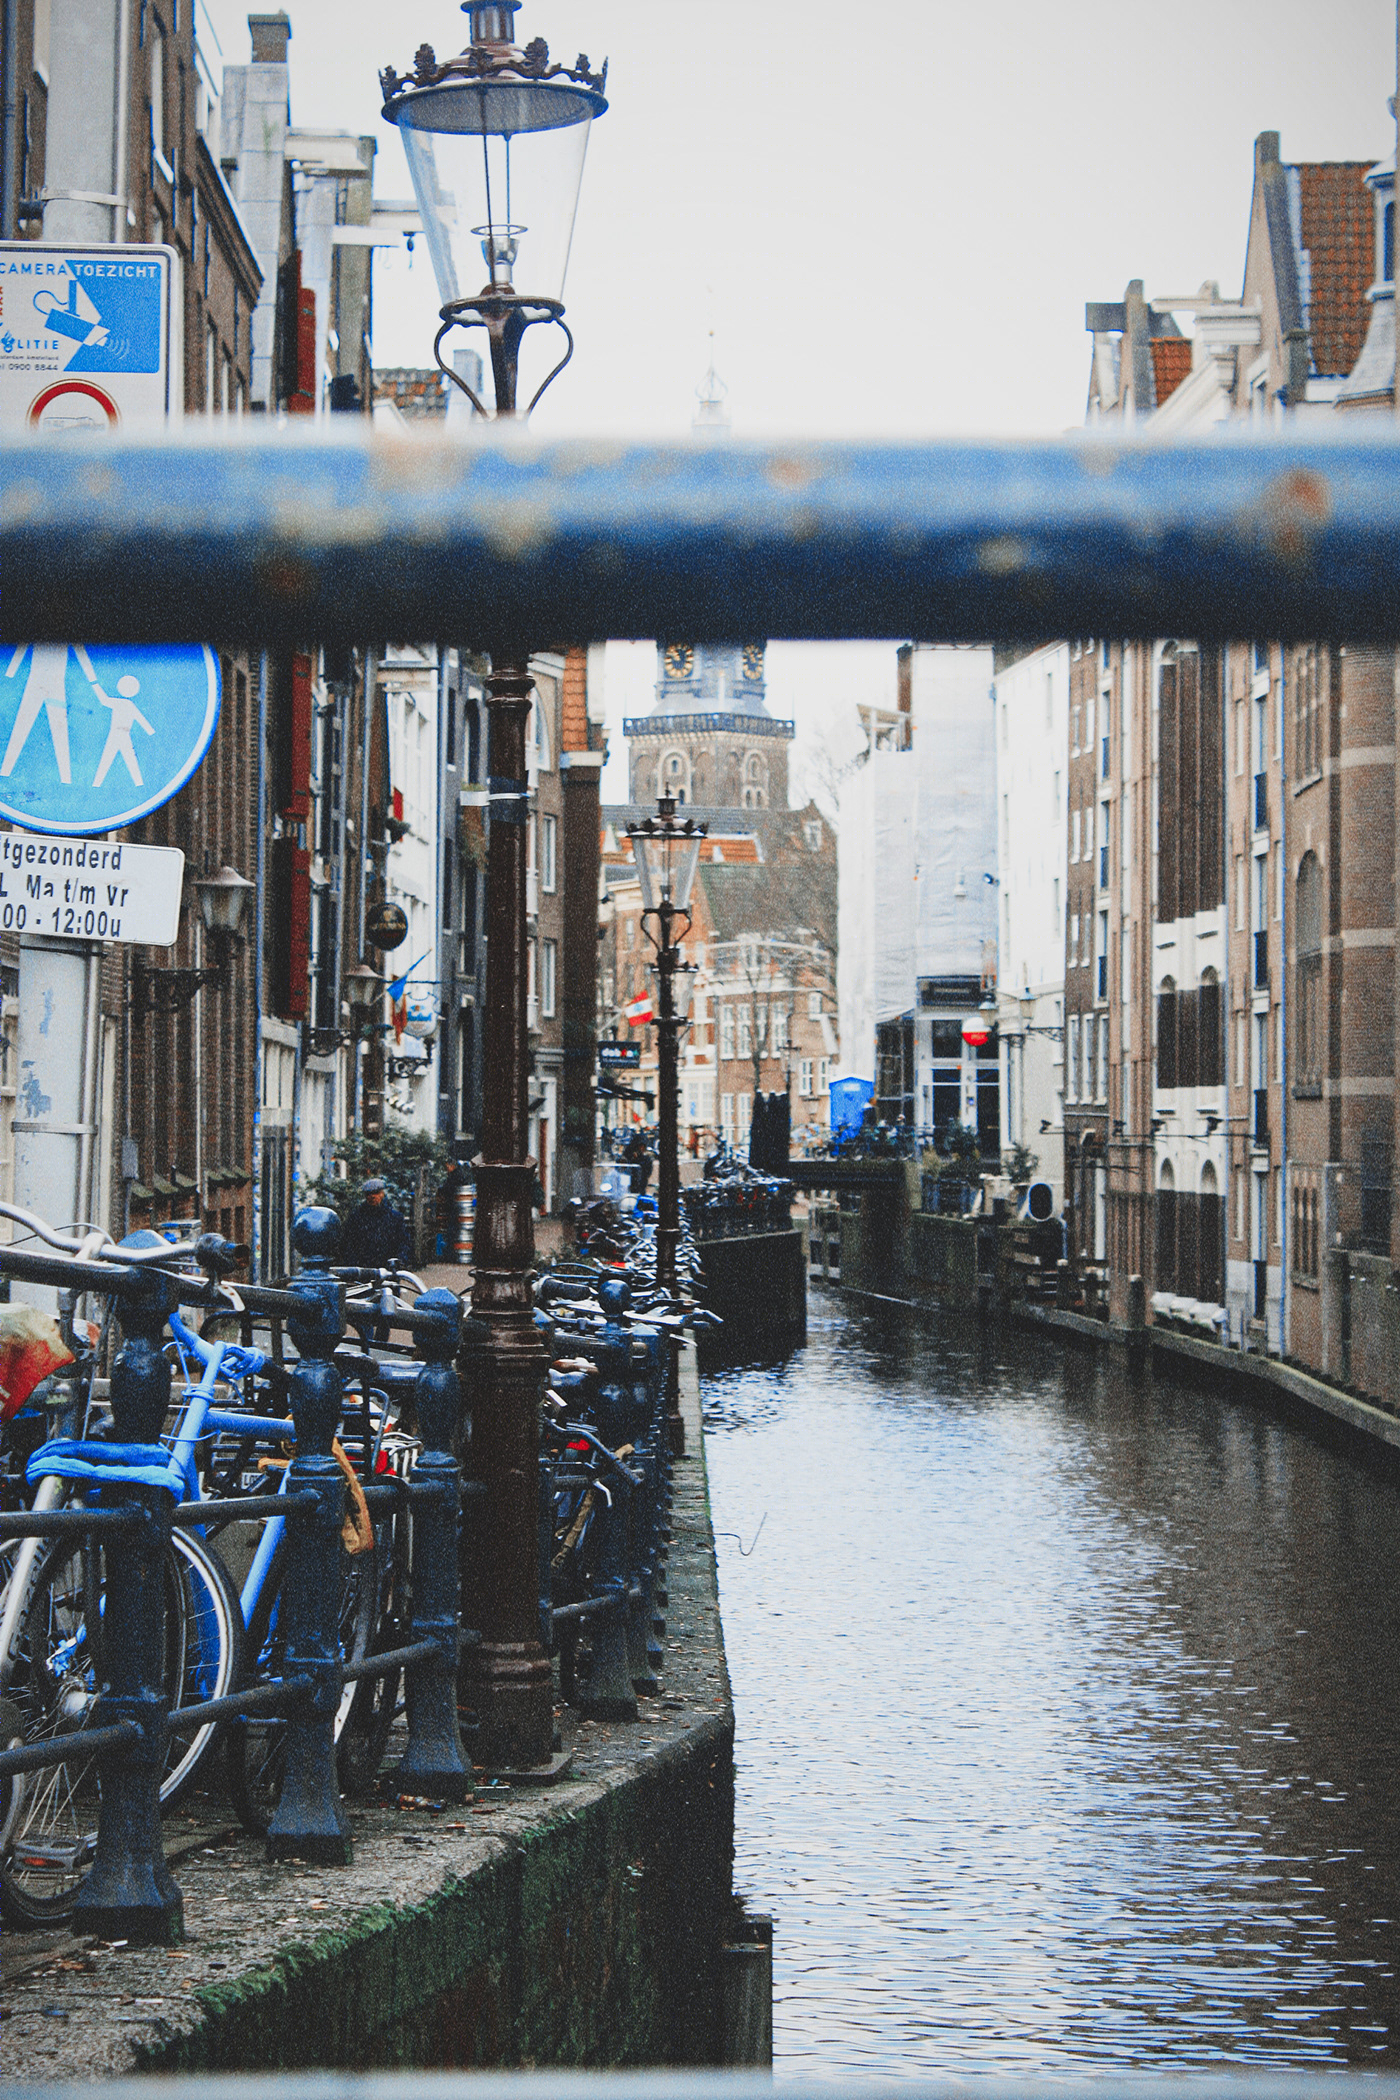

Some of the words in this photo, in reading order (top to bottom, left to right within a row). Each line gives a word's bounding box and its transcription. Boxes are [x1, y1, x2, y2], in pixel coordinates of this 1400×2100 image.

[0, 262, 68, 276] CAMERA
[74, 263, 157, 278] TOEZICHT
[8, 363, 31, 371] 0900
[26, 874, 54, 900] Ma
[64, 877, 96, 905] t/m
[51, 906, 121, 938] 12:00u
